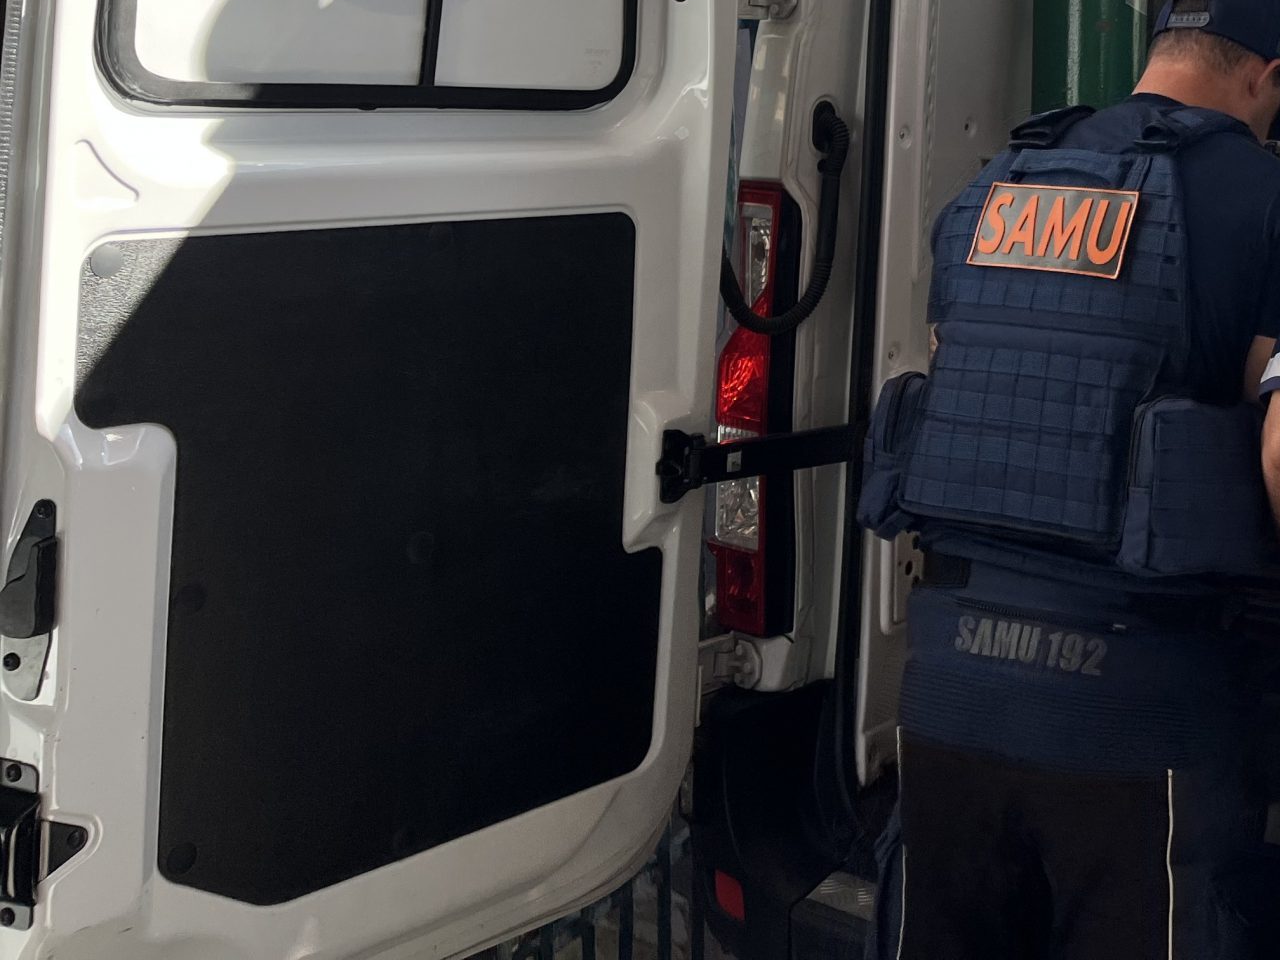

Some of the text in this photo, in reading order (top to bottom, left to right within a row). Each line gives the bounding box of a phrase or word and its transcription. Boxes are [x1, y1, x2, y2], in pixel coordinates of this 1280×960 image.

[978, 192, 1132, 265] SAMU
[954, 615, 1108, 676] SAMU 192
